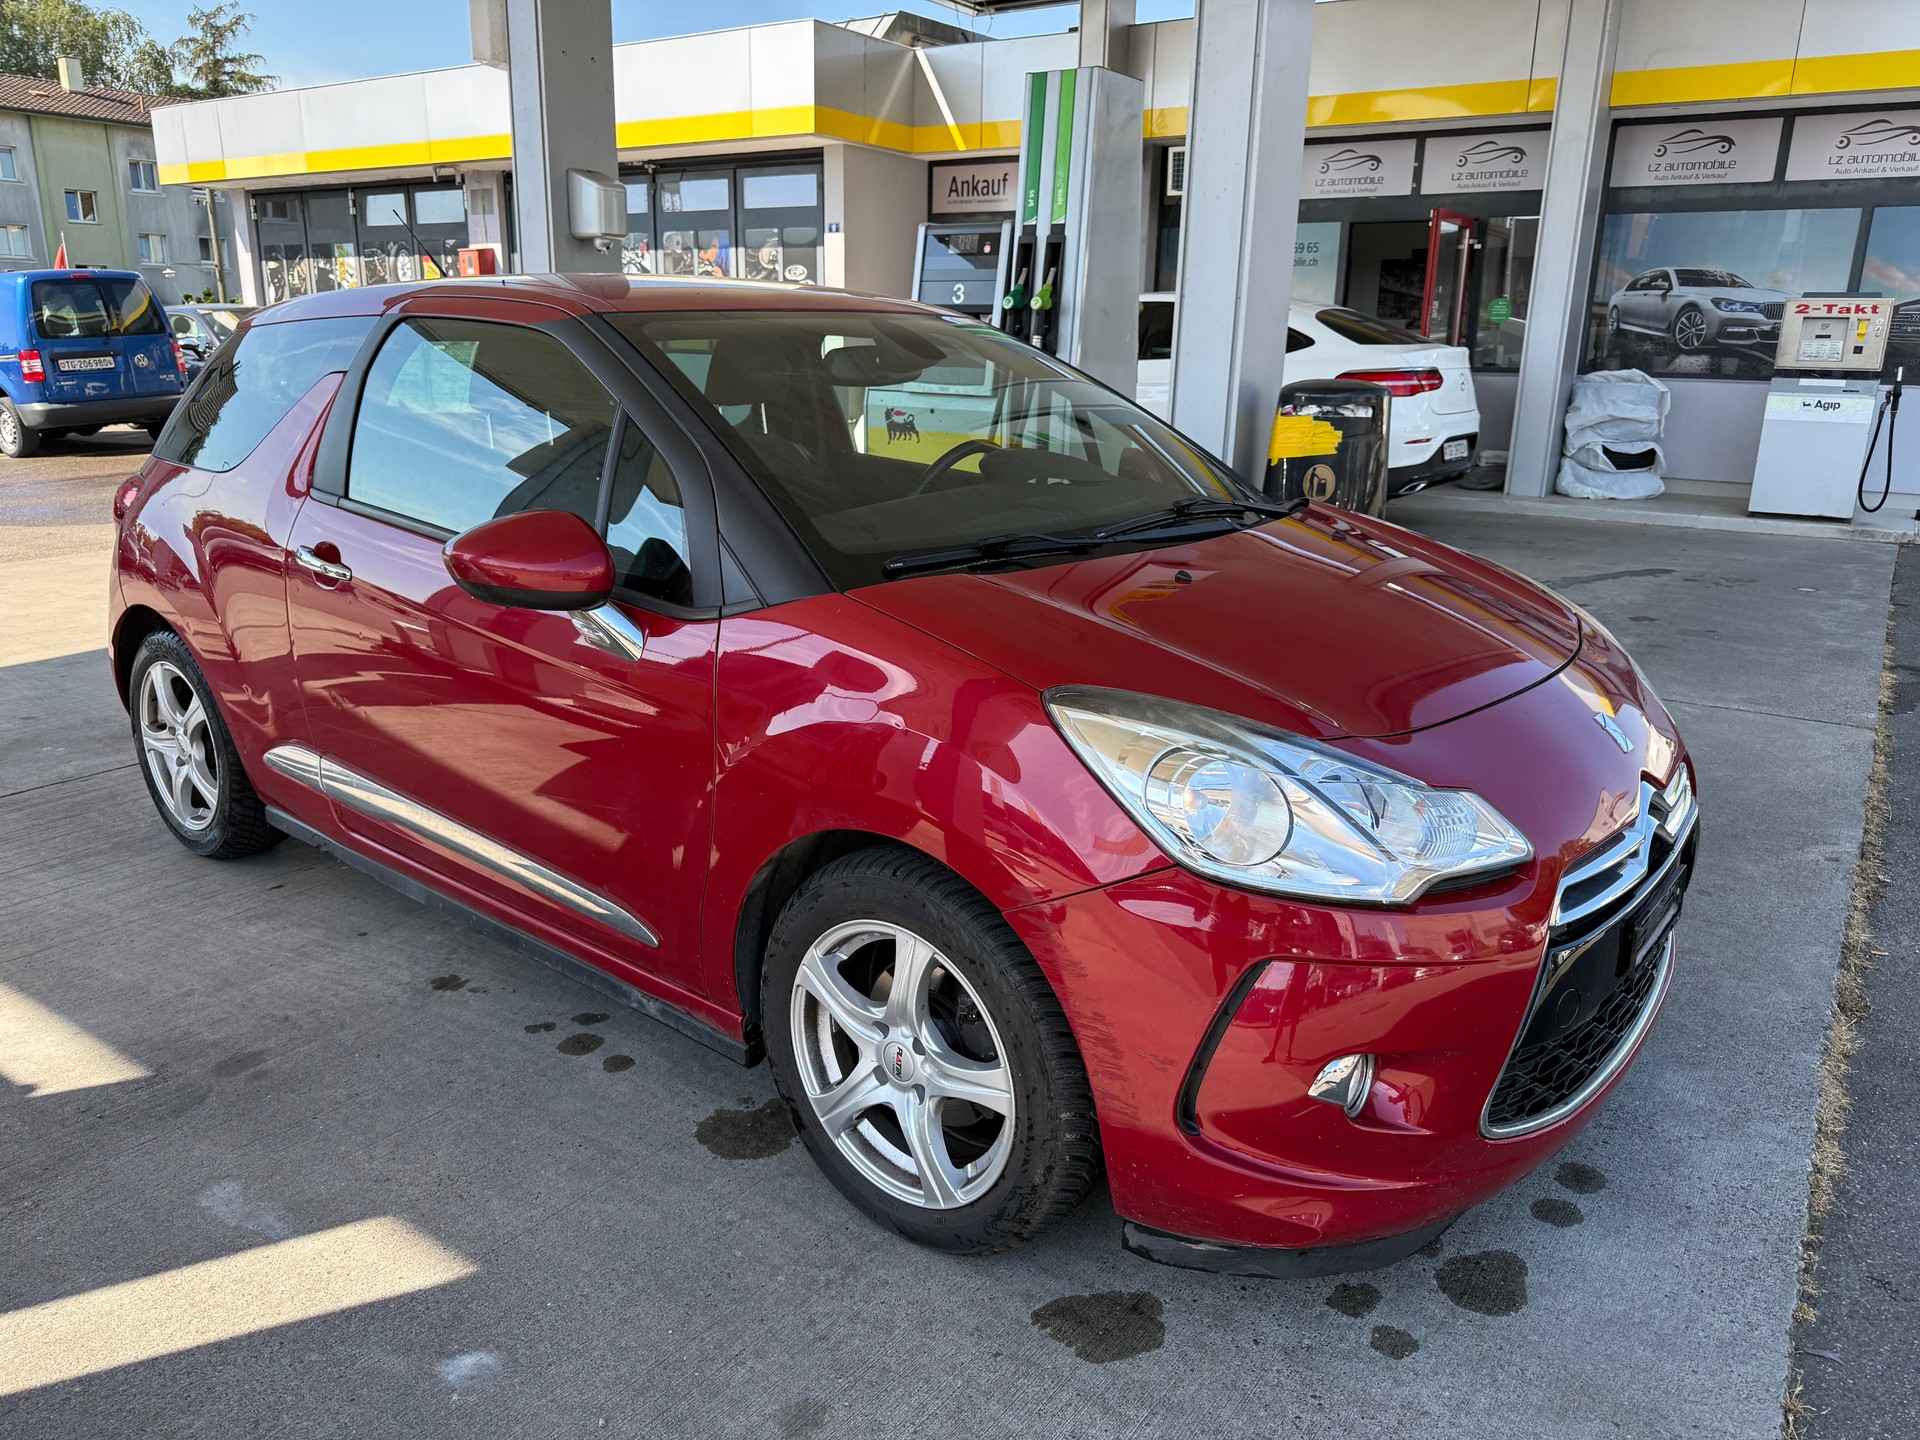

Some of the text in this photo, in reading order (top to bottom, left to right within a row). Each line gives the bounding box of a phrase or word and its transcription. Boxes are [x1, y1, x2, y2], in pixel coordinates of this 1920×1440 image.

[1828, 151, 1920, 165] LZ automobil
[1648, 163, 1662, 172] LZ
[1889, 165, 1919, 173] Verkauf
[1451, 172, 1463, 181] LZ
[1670, 173, 1694, 181] Ankauf
[1701, 172, 1728, 180] Verkauf
[948, 173, 1008, 198] Ankauf
[1315, 179, 1326, 187] LZ
[1306, 242, 1320, 254] 65
[952, 284, 965, 304] 3
[1795, 304, 1880, 314] 2-Takt
[1814, 400, 1841, 411] Agip
